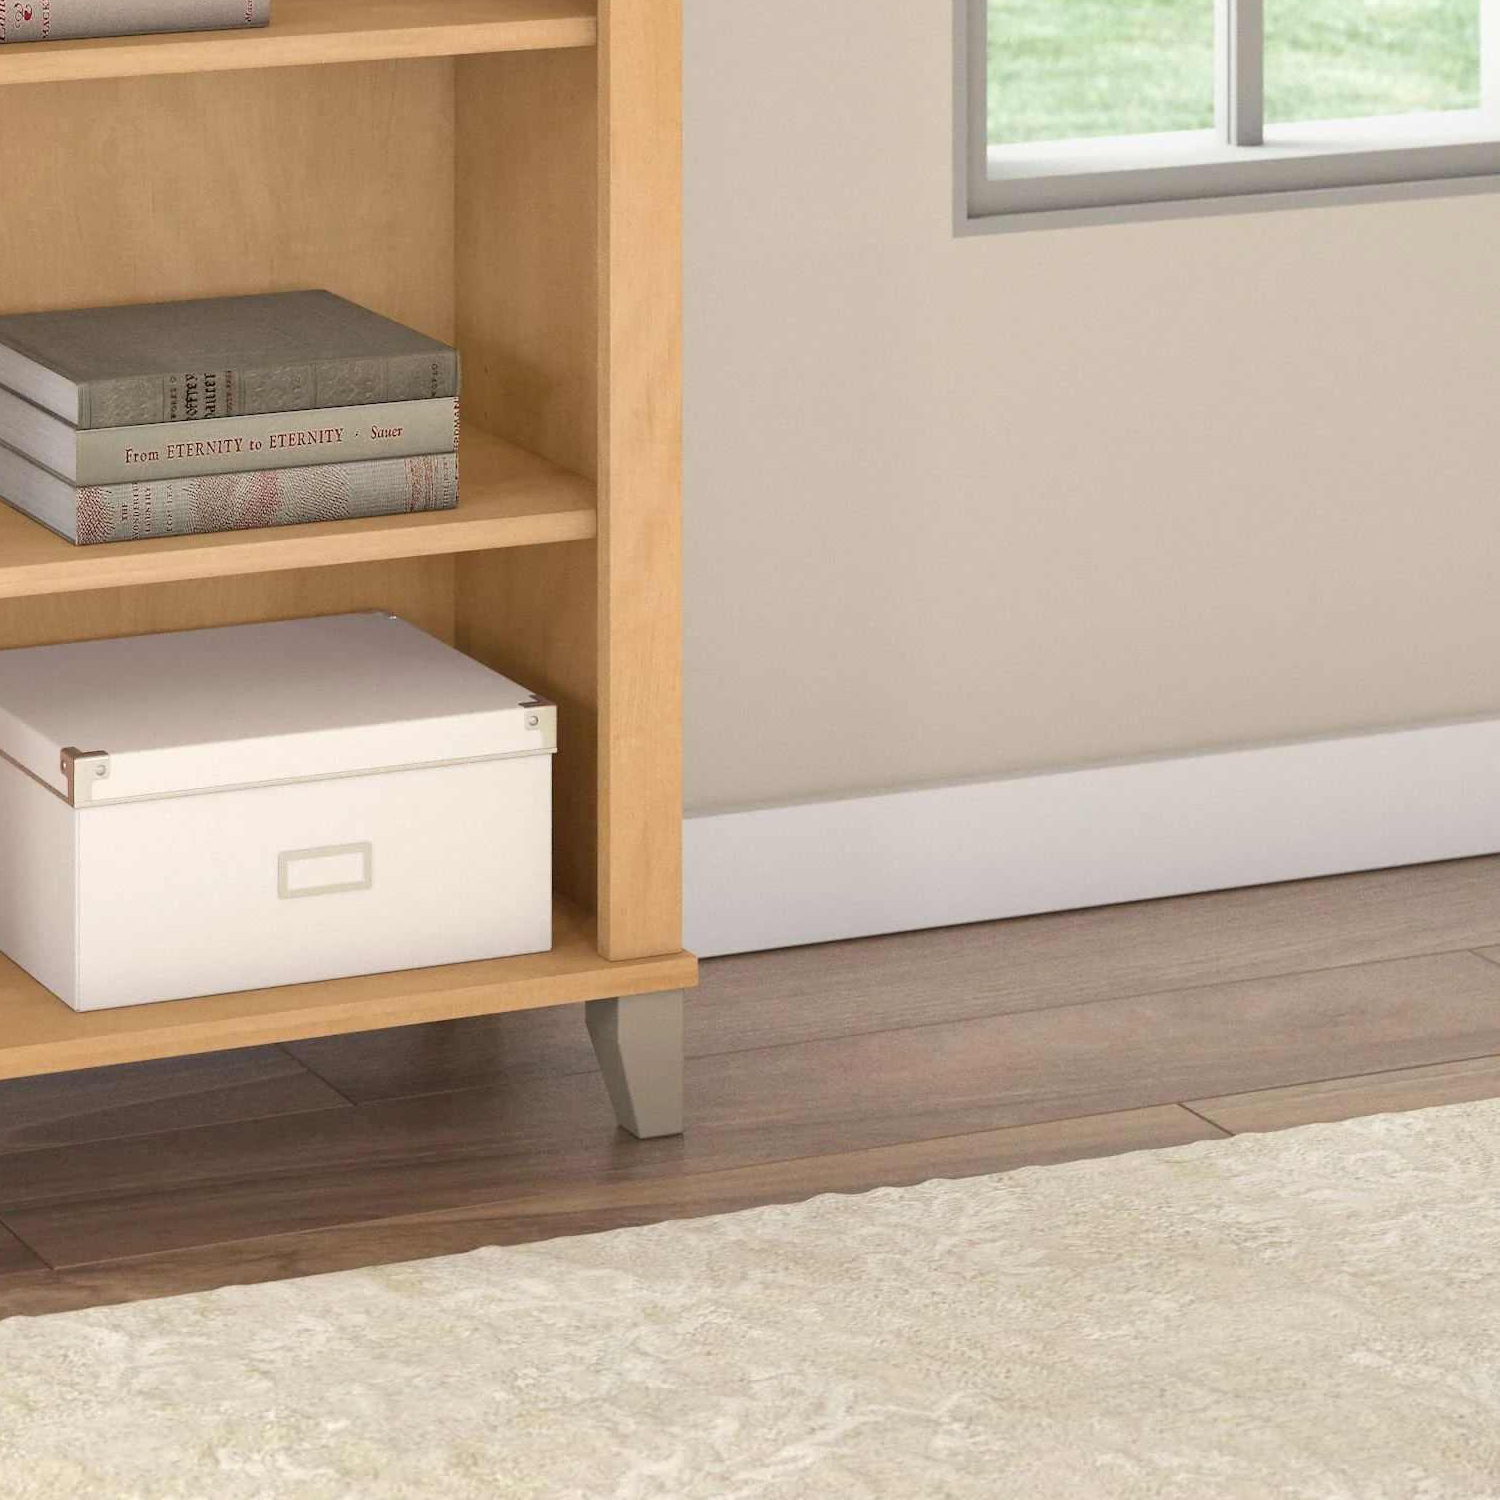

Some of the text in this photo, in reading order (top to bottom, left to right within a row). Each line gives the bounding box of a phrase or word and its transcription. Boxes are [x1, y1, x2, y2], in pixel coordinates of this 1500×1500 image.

[185, 373, 198, 419] offrey
[124, 425, 404, 464] From ETERNITY to ETERNITY Sauer
